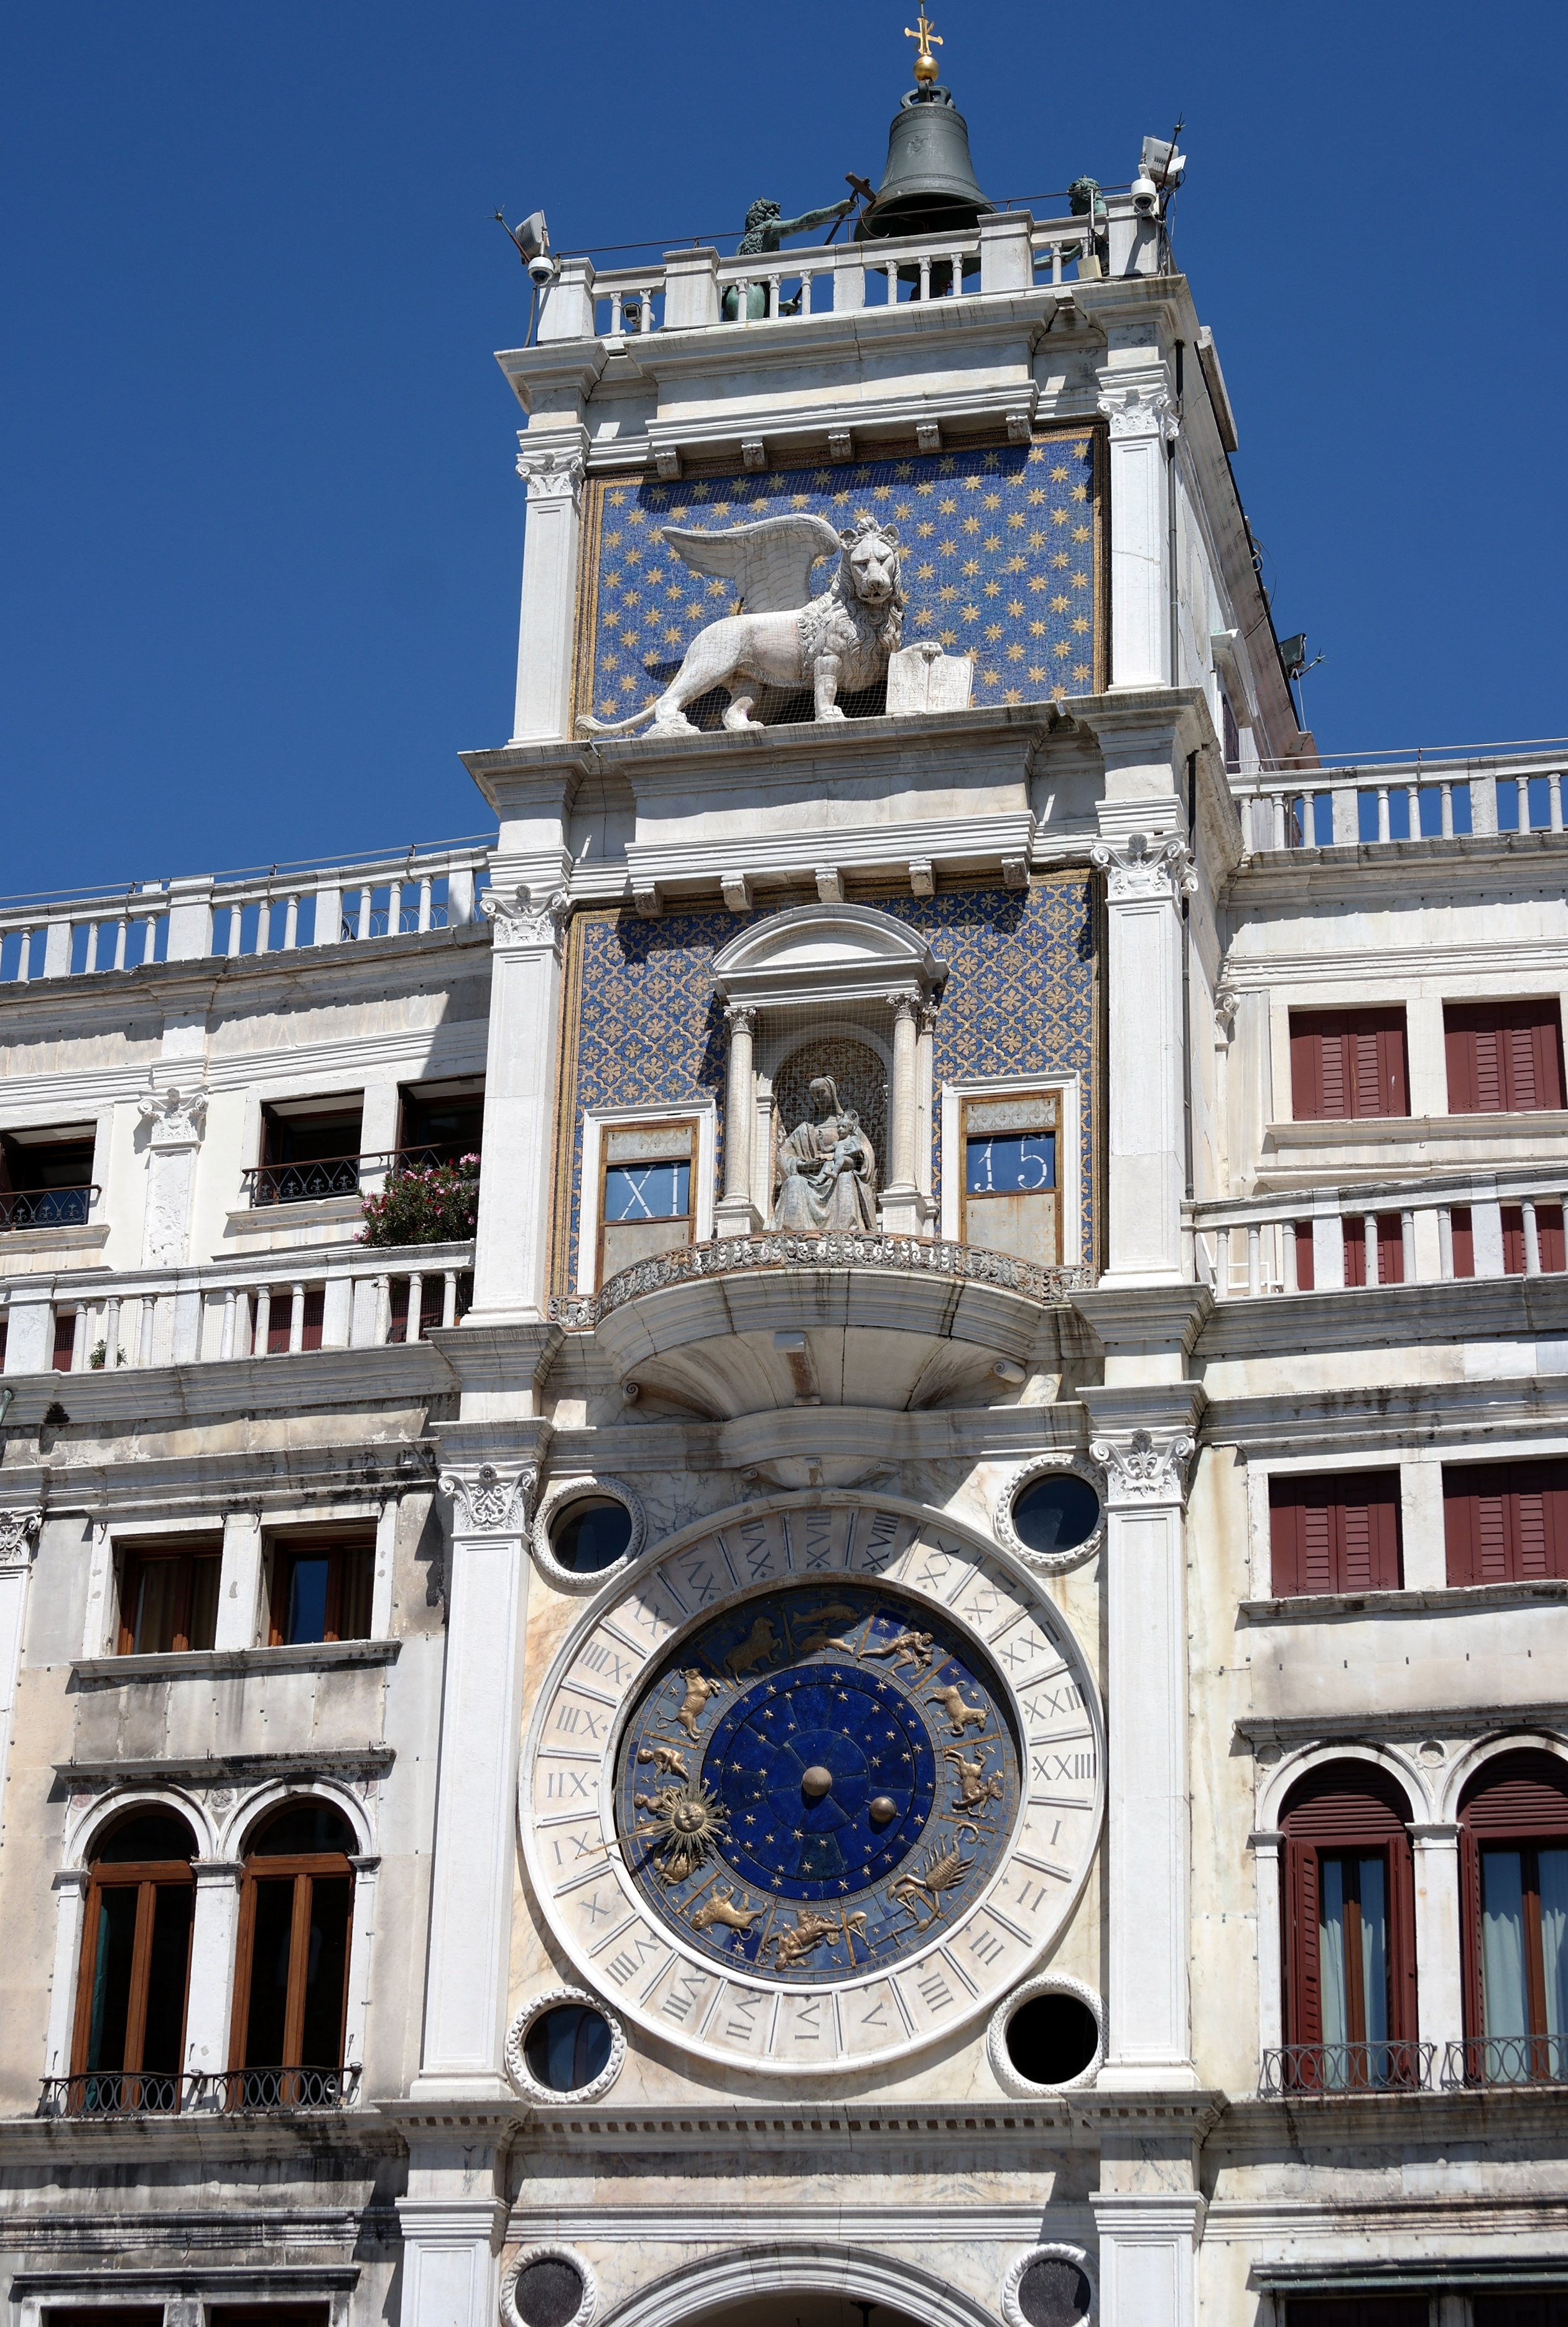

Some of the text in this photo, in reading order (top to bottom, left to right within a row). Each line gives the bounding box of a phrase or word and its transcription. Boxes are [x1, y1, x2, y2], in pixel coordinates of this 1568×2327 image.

[618, 1162, 681, 1221] XI
[740, 1518, 774, 1579] XVII
[806, 1508, 831, 1568] XVIII
[862, 1510, 900, 1572] XVIIII
[677, 1545, 721, 1604] XVI
[916, 1539, 962, 1591] XX
[624, 1594, 672, 1638] XV
[963, 1569, 1018, 1626] XXI
[578, 1641, 632, 1686] XIIII
[997, 1620, 1060, 1671] XXII
[555, 1704, 605, 1739] XIII
[1023, 1683, 1087, 1724] XXIII
[547, 1771, 591, 1798] XII
[1031, 1753, 1096, 1781] XXIIII
[1049, 1819, 1062, 1846] I
[577, 1891, 611, 1925] X
[1016, 1879, 1049, 1913] II
[604, 1938, 661, 1987] VIIII
[968, 1929, 1006, 1967] III
[661, 1976, 708, 2023] VIII
[917, 1971, 955, 2014] IIII
[725, 1996, 762, 2041] VII
[794, 2001, 820, 2041] VI
[860, 2002, 888, 2028] V
